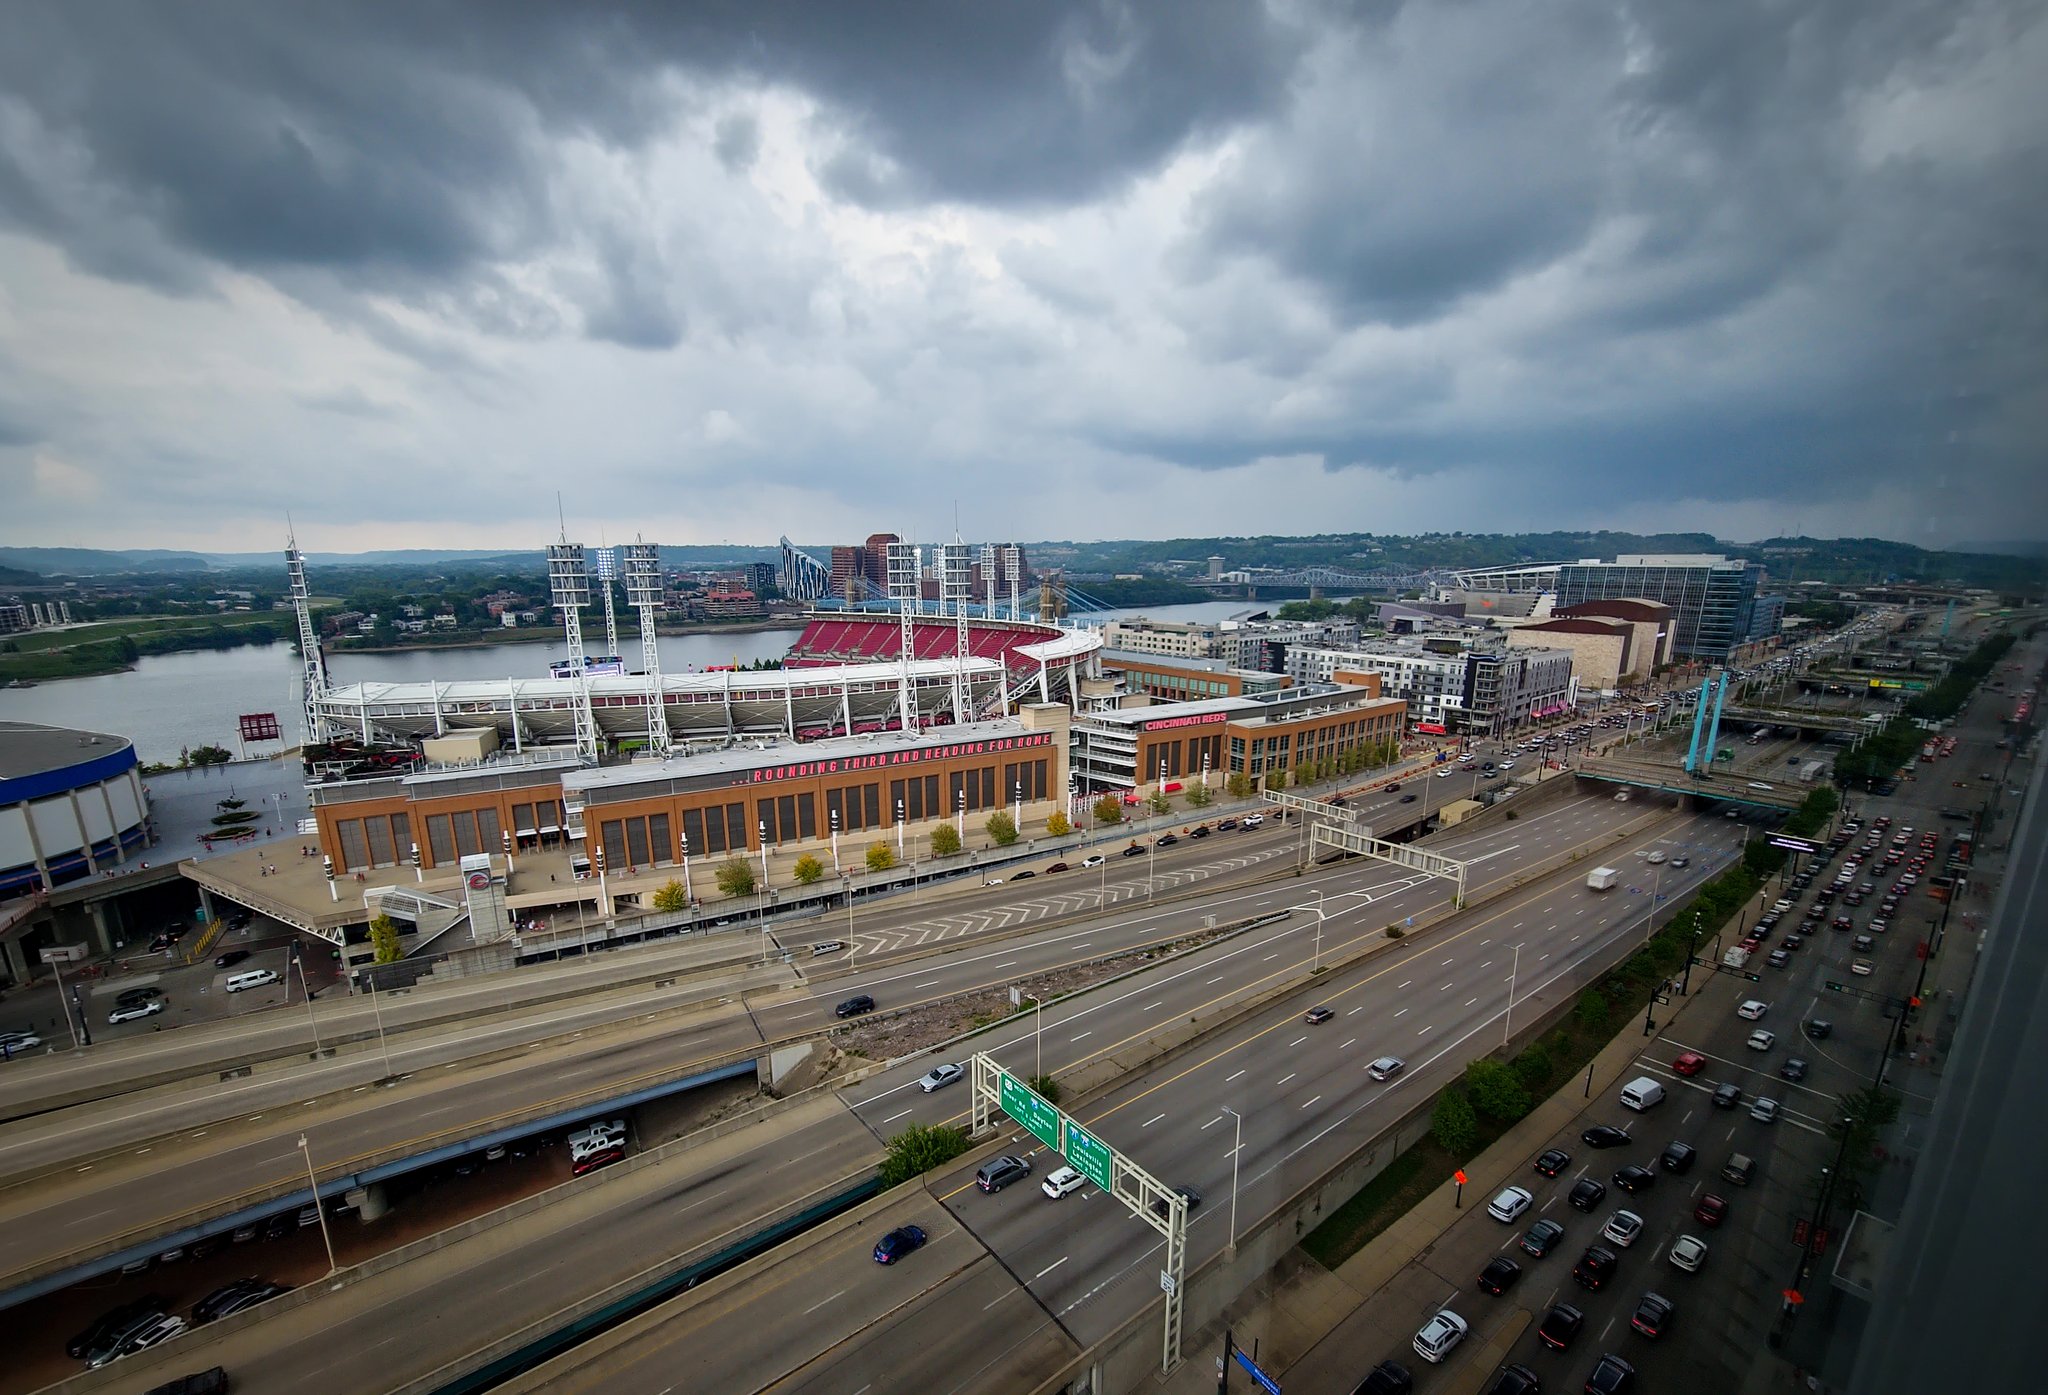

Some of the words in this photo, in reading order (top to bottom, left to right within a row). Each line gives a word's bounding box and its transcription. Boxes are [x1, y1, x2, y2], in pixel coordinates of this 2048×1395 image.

[1145, 716, 1201, 731] CINCINNATI
[1202, 713, 1227, 724] REDS
[843, 753, 887, 770] THIRD
[892, 751, 920, 764] AND
[925, 743, 984, 760] HEADING
[989, 739, 1013, 752] FOR
[1017, 734, 1051, 748] HOME
[1072, 1141, 1102, 1168] Louisville
[1072, 1149, 1103, 1177] Lexington
